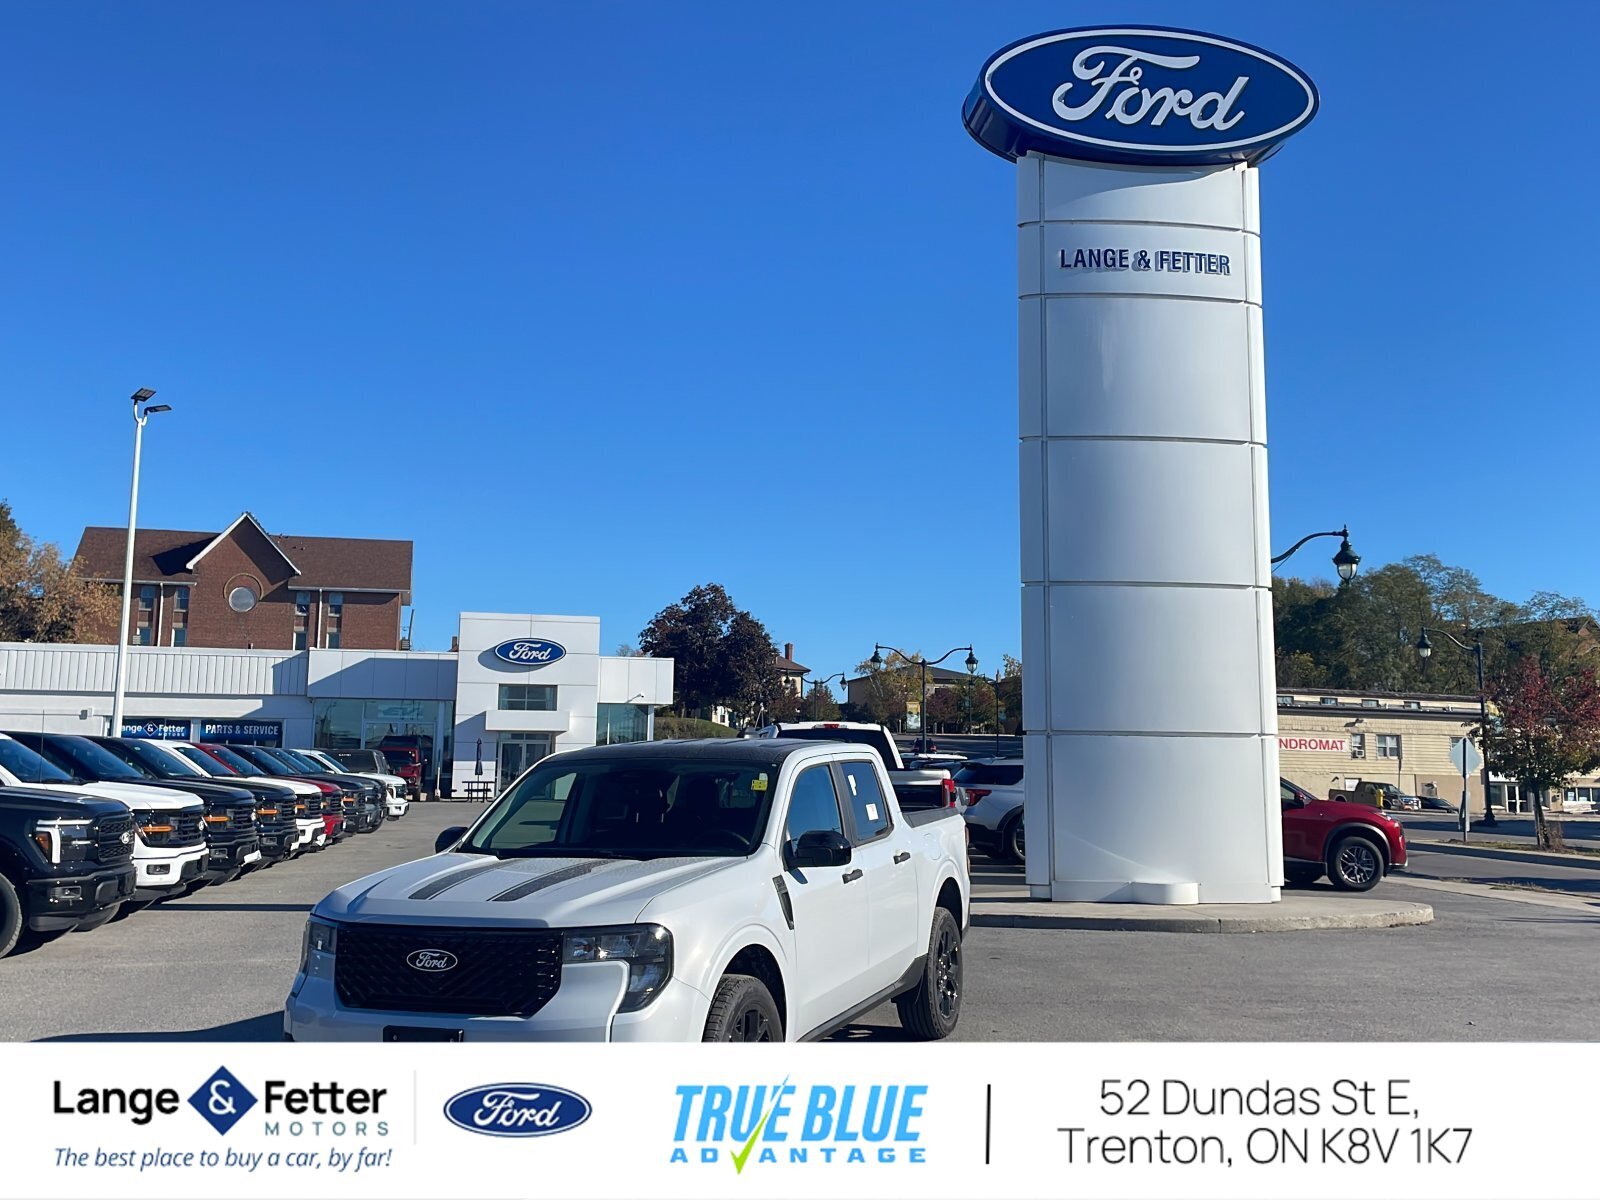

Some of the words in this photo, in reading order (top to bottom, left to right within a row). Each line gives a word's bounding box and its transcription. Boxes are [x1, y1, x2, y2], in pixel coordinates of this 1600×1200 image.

[1052, 45, 1250, 131] Ford
[1060, 248, 1129, 269] LANGE
[1137, 249, 1151, 270] &
[1159, 250, 1231, 275] FETTER
[508, 642, 552, 660] Ford
[121, 724, 142, 734] ange
[158, 724, 185, 733] Fetter
[205, 724, 233, 735] PARTS
[235, 725, 241, 735] &
[243, 725, 279, 736] SERVICE
[1279, 738, 1345, 751] NDROMAT
[415, 951, 448, 969] Ford
